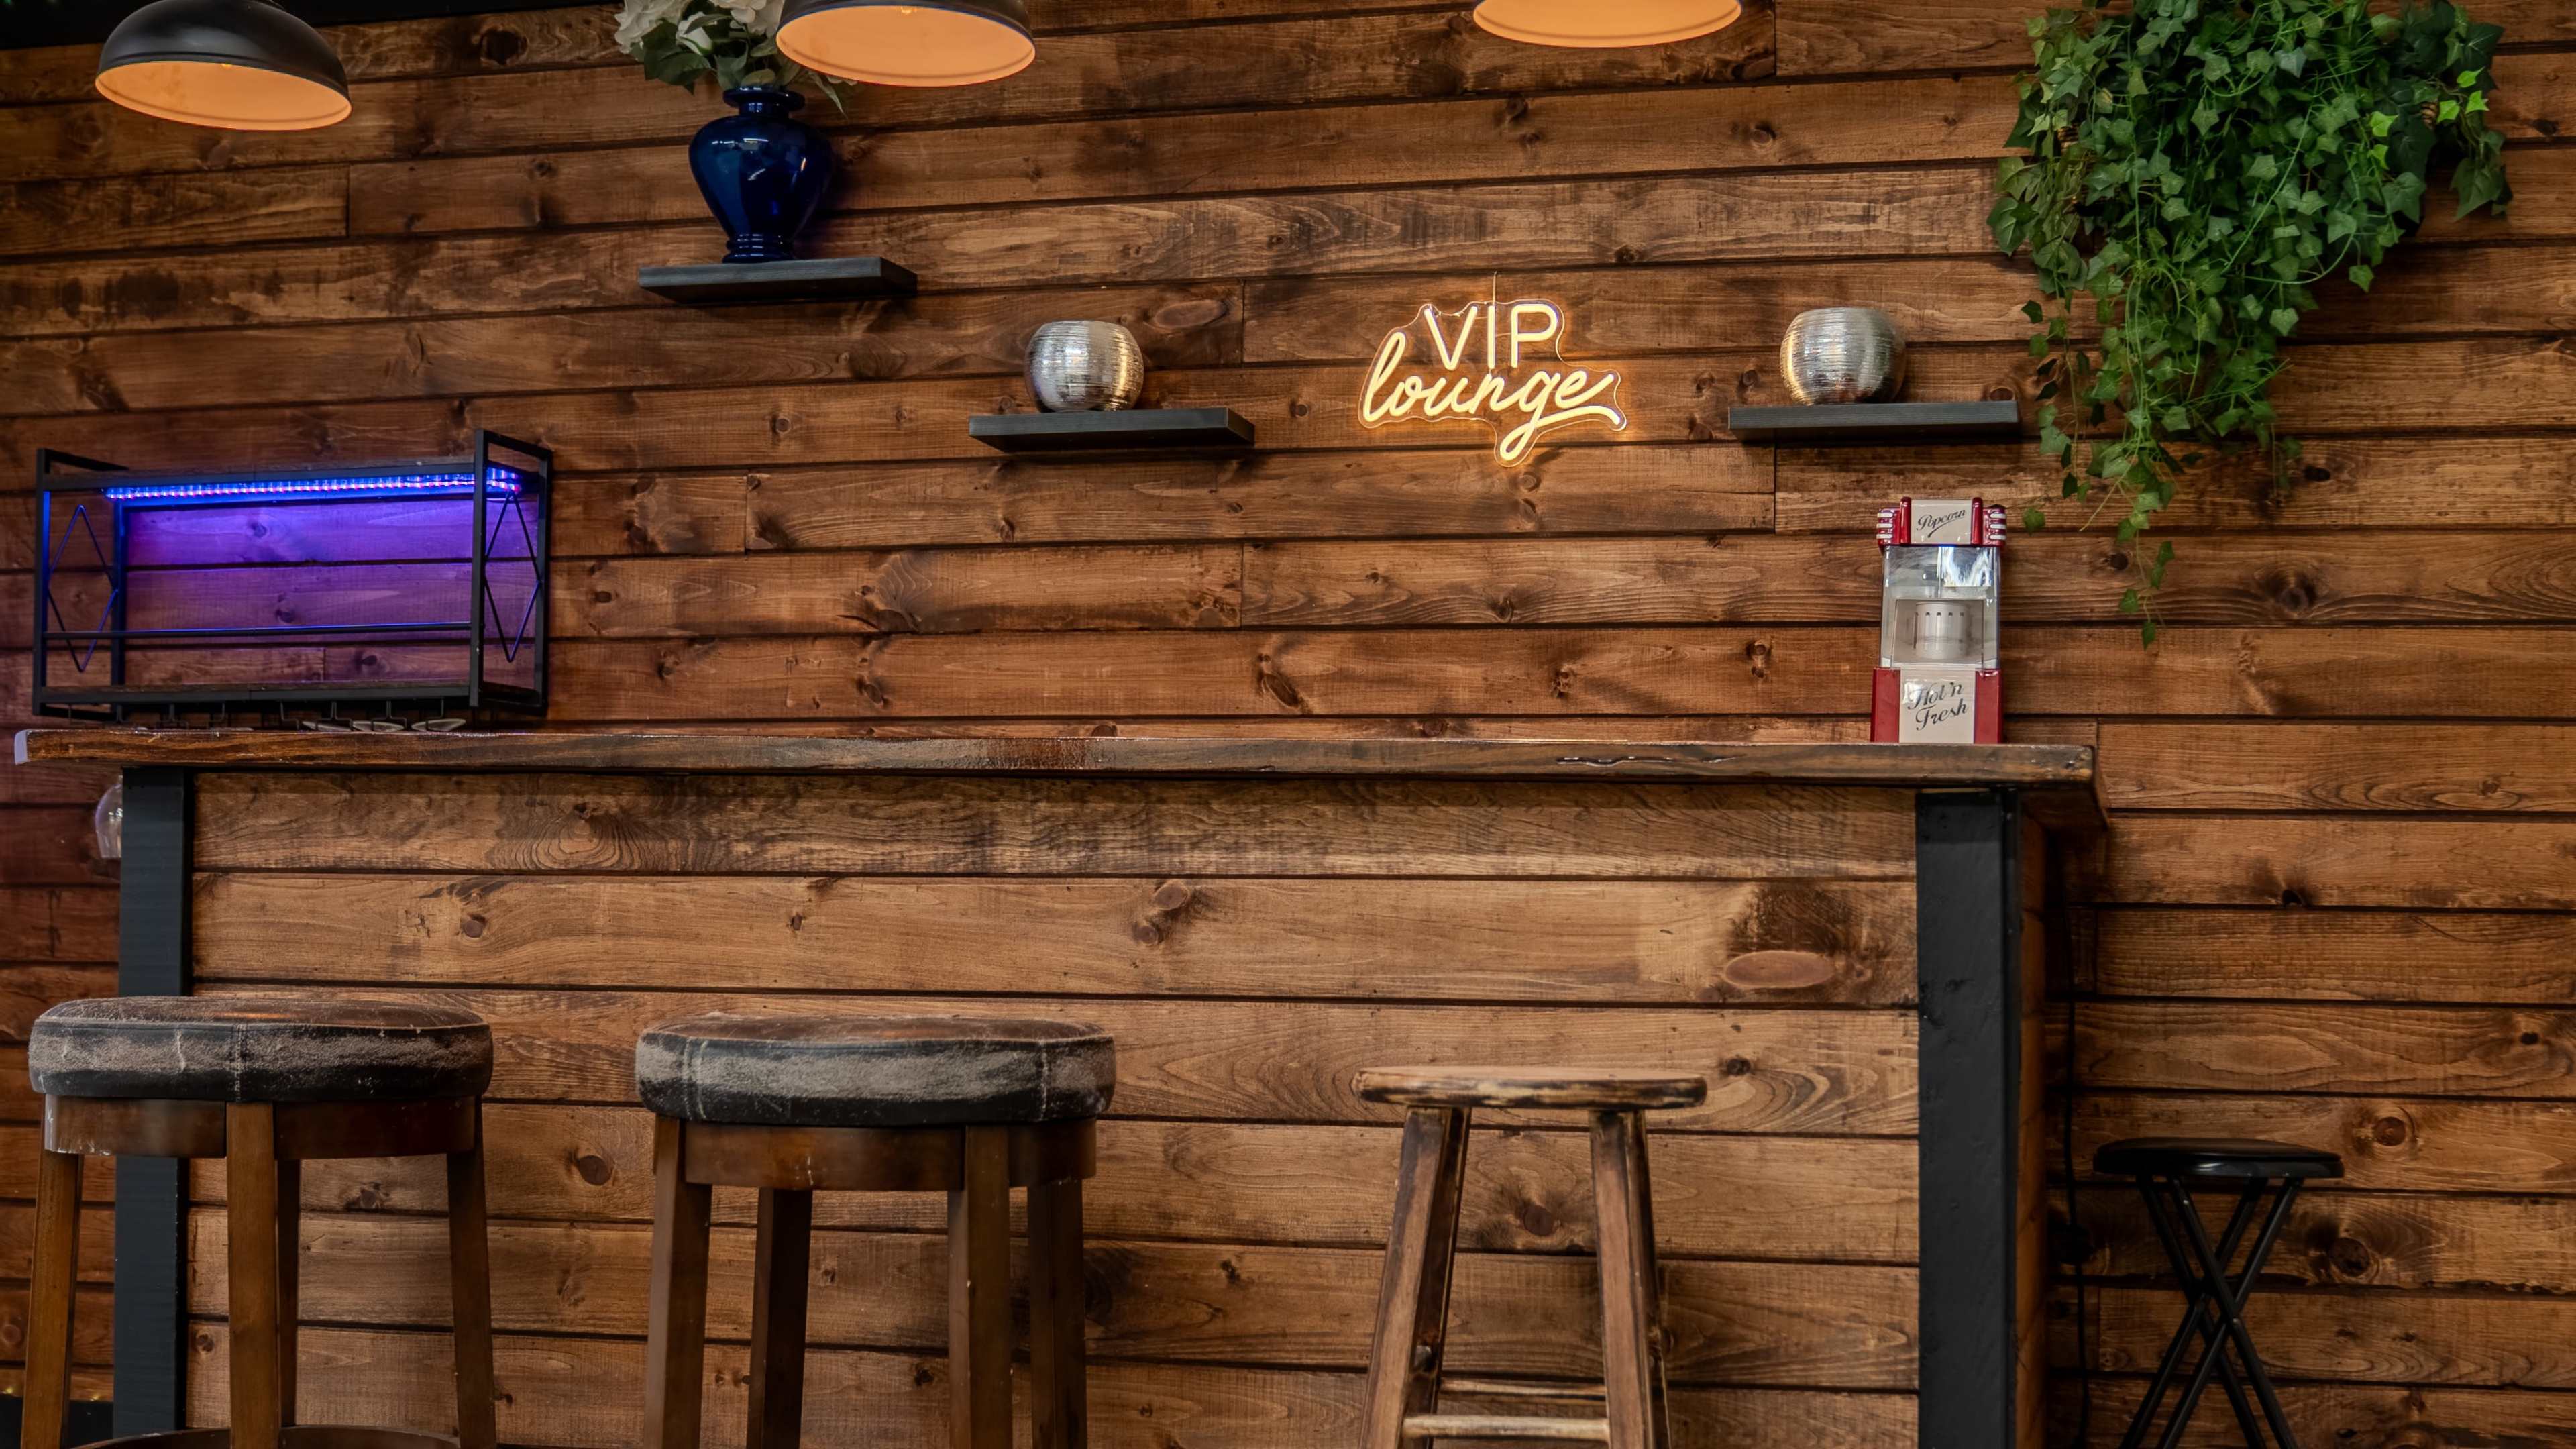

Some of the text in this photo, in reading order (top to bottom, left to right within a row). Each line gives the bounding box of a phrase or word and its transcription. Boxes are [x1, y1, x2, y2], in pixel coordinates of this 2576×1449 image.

[1424, 303, 1559, 371] VIP
[1362, 331, 1621, 461] lounge
[1917, 509, 1966, 538] Popcorn
[1915, 698, 1968, 731] Fresh
